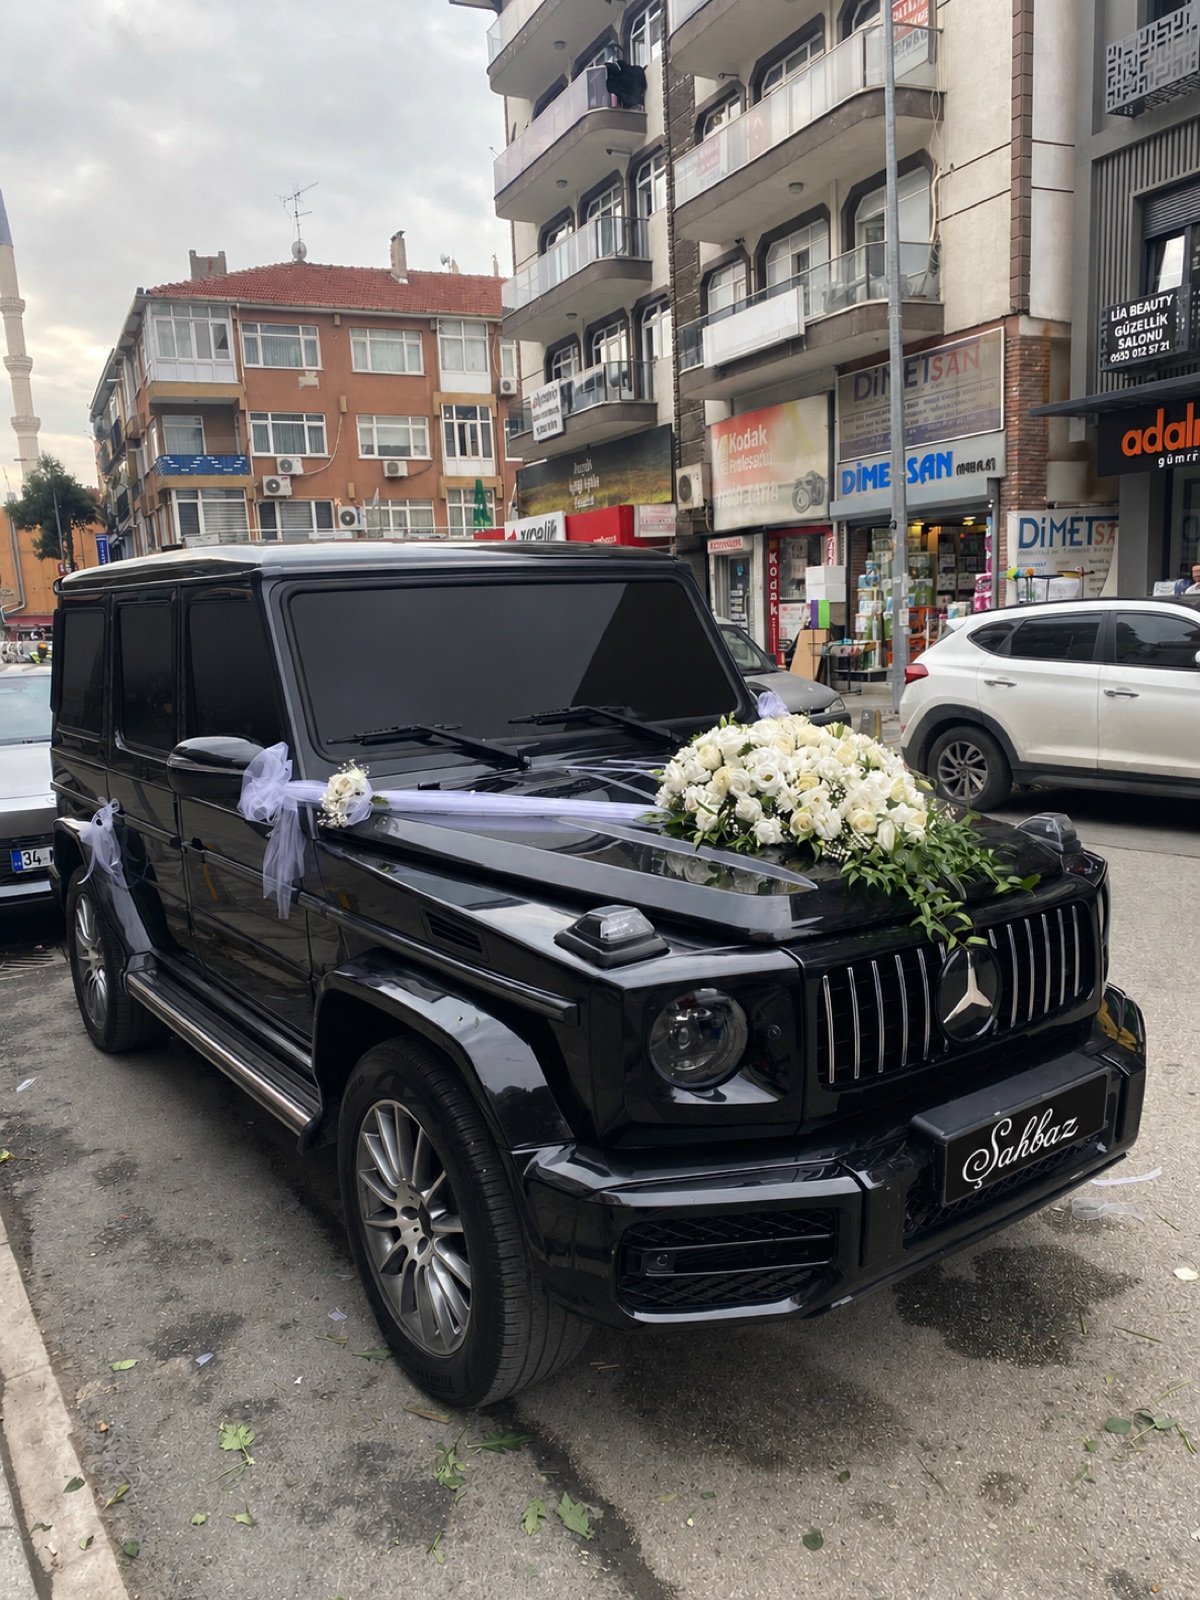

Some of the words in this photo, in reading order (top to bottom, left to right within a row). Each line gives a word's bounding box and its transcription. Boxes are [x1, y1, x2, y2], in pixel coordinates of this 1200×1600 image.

[1111, 306, 1128, 322] LİA
[1129, 294, 1174, 317] BEAUTY
[1114, 312, 1169, 337] GÜZELLİK
[1118, 328, 1163, 350] SALONU
[1160, 340, 1170, 351] 21
[728, 424, 768, 454] Kodak
[842, 451, 953, 495] DİMESAN
[769, 552, 778, 615] Kodak
[22, 850, 42, 866] 34
